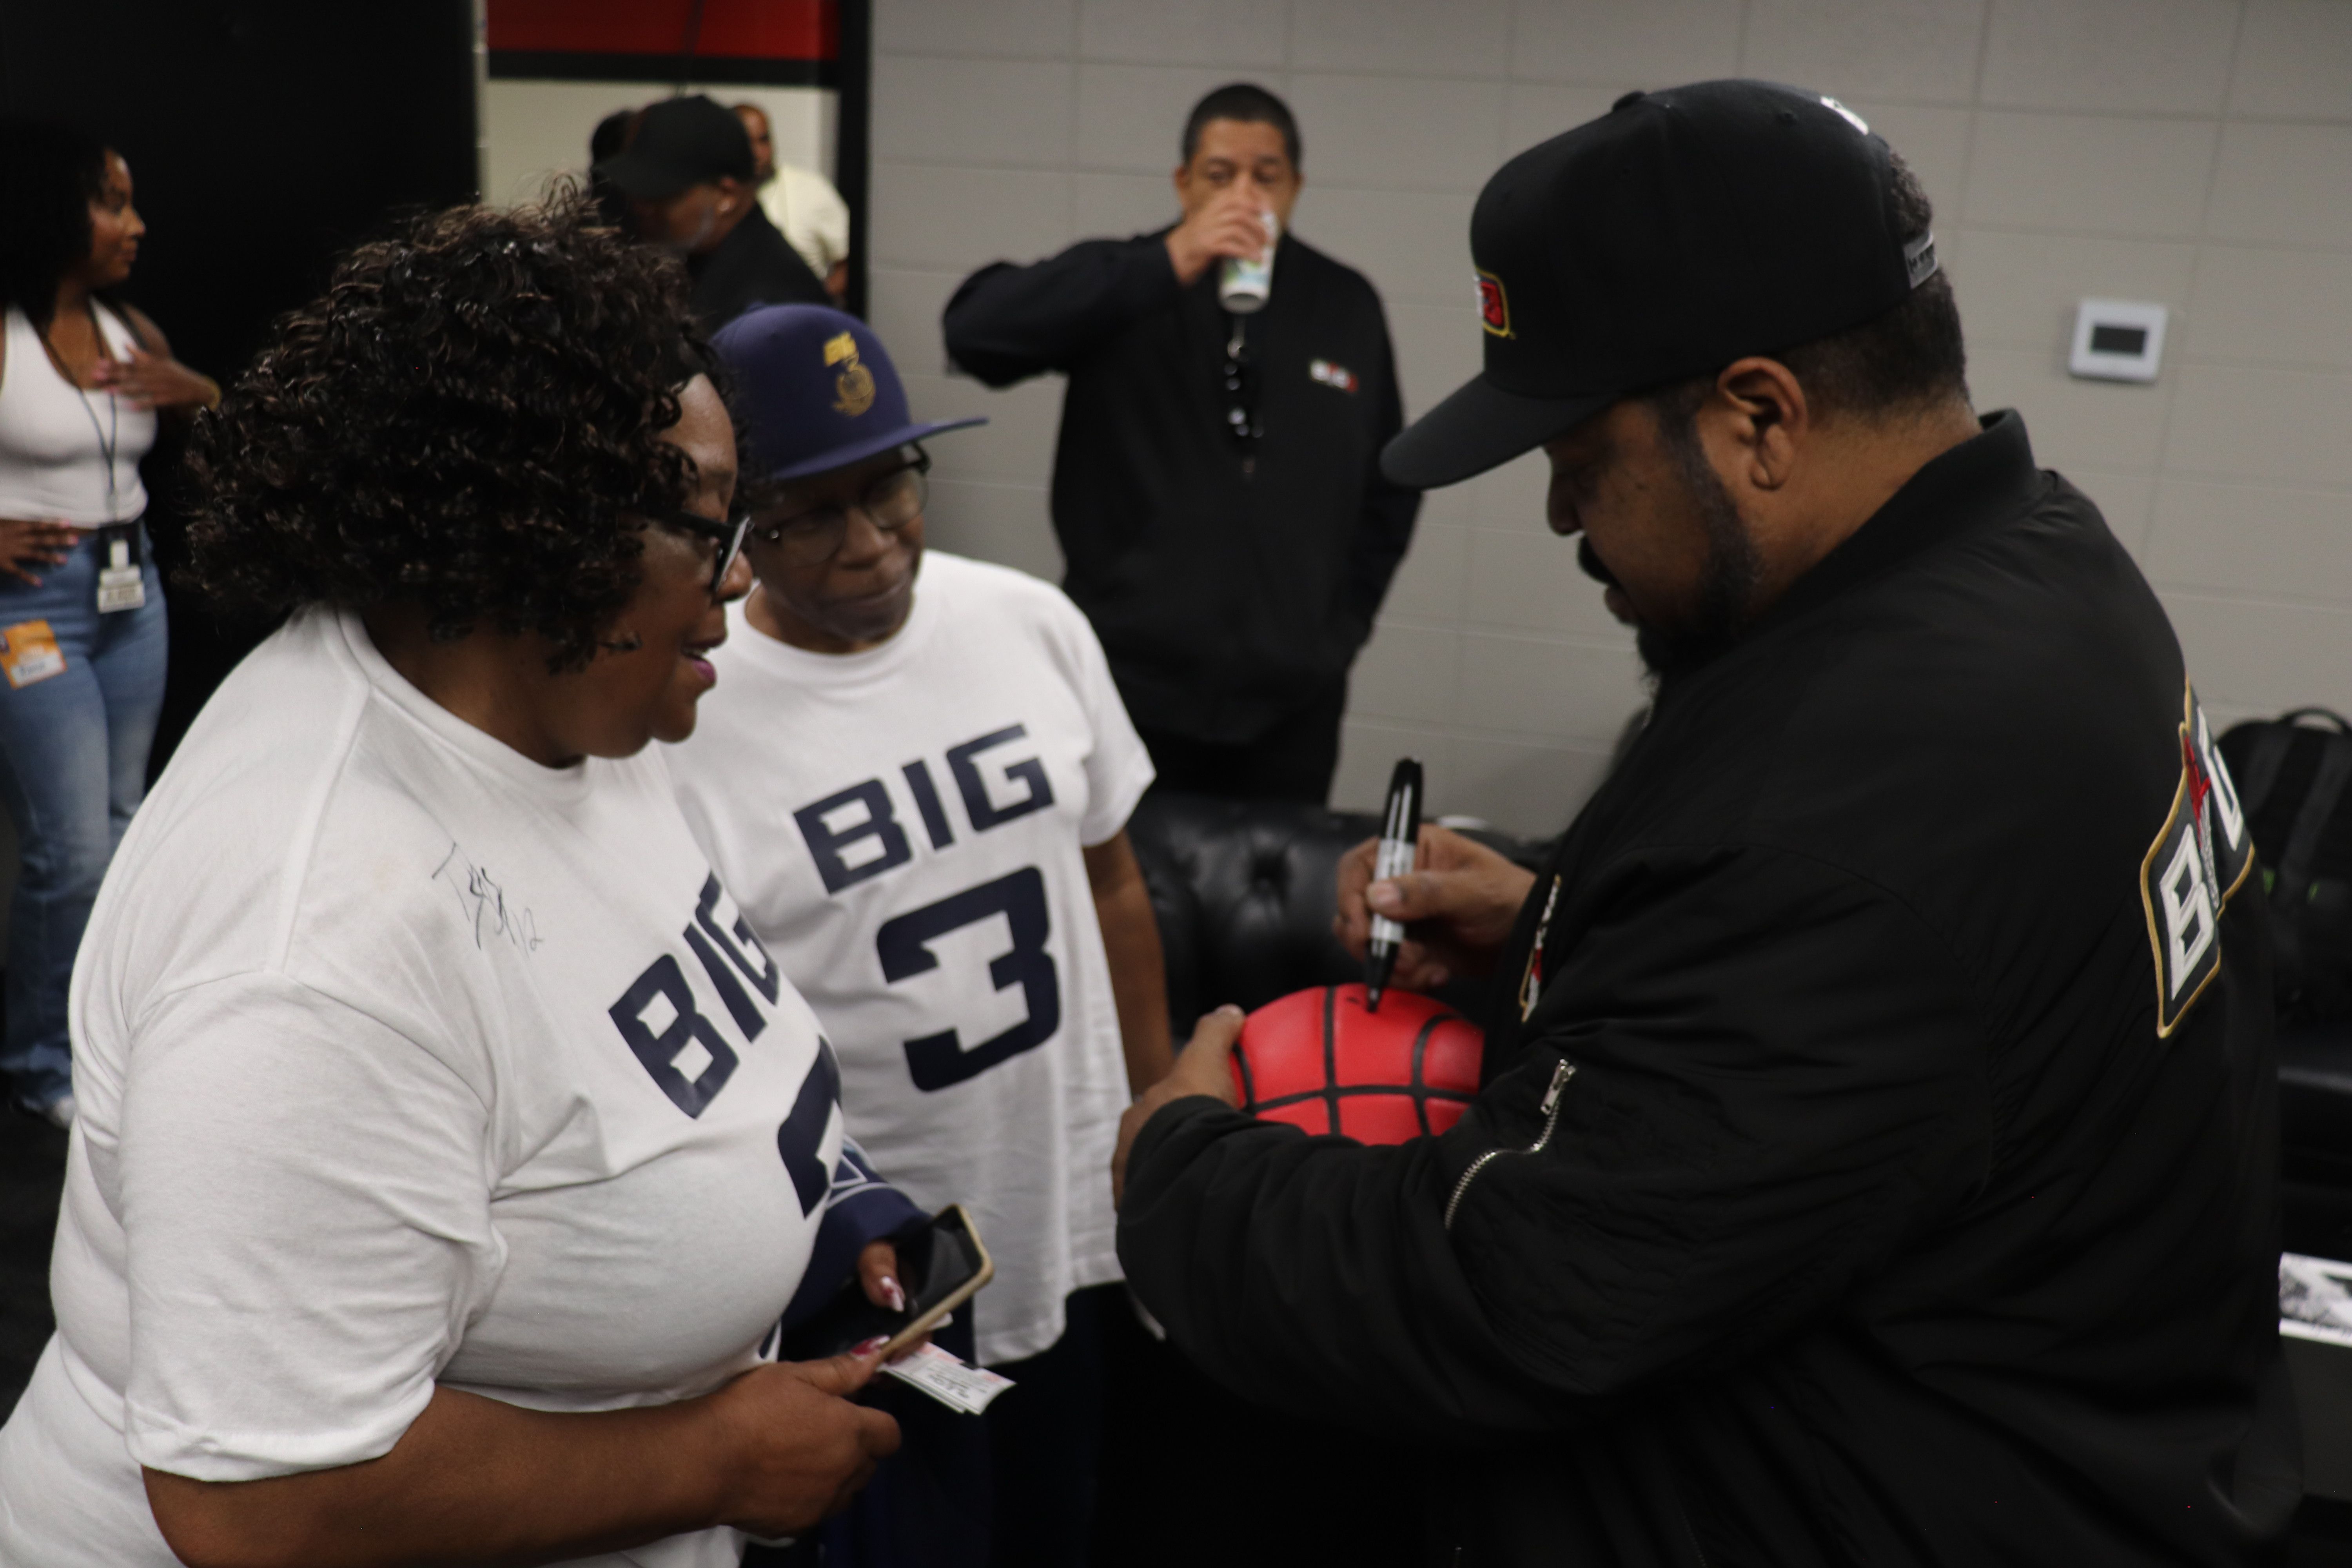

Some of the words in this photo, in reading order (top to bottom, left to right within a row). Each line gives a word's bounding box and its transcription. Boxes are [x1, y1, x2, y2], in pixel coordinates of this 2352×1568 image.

[792, 723, 1056, 895] BIG
[608, 869, 779, 1120] BIG
[876, 866, 1060, 1093] 3
